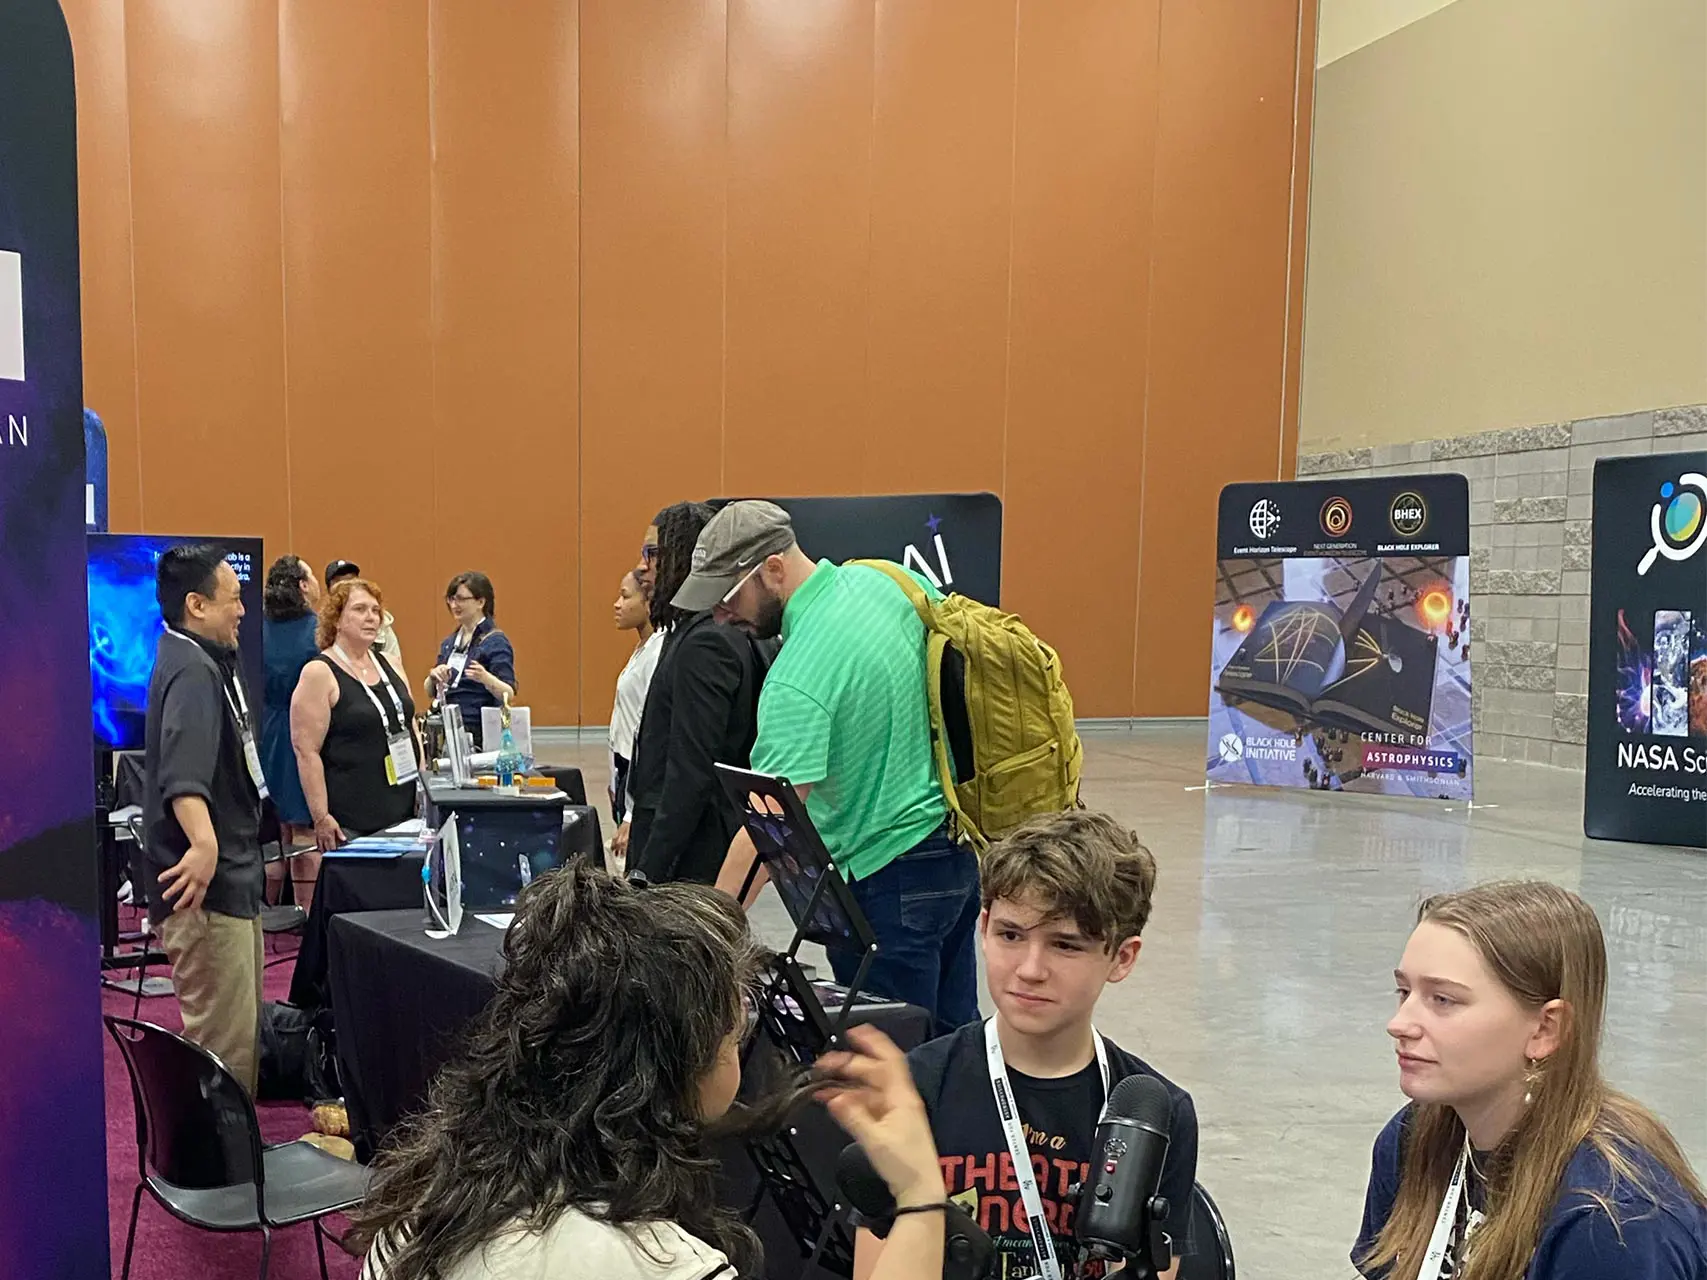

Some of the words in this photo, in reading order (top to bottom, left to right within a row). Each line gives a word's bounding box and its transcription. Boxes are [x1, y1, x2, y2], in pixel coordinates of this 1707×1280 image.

[1394, 508, 1422, 520] BHEX
[1245, 737, 1273, 748] BLACK
[1274, 738, 1297, 749] HOLE
[1360, 731, 1404, 744] CENTER
[1410, 734, 1433, 746] FOR
[1245, 748, 1297, 761] INITIATIVE
[1366, 751, 1455, 768] ASTROPHYSICS
[1617, 742, 1680, 771] NASA
[1628, 782, 1690, 802] Accelerating
[1691, 787, 1707, 801] the
[1050, 1134, 1067, 1150] a
